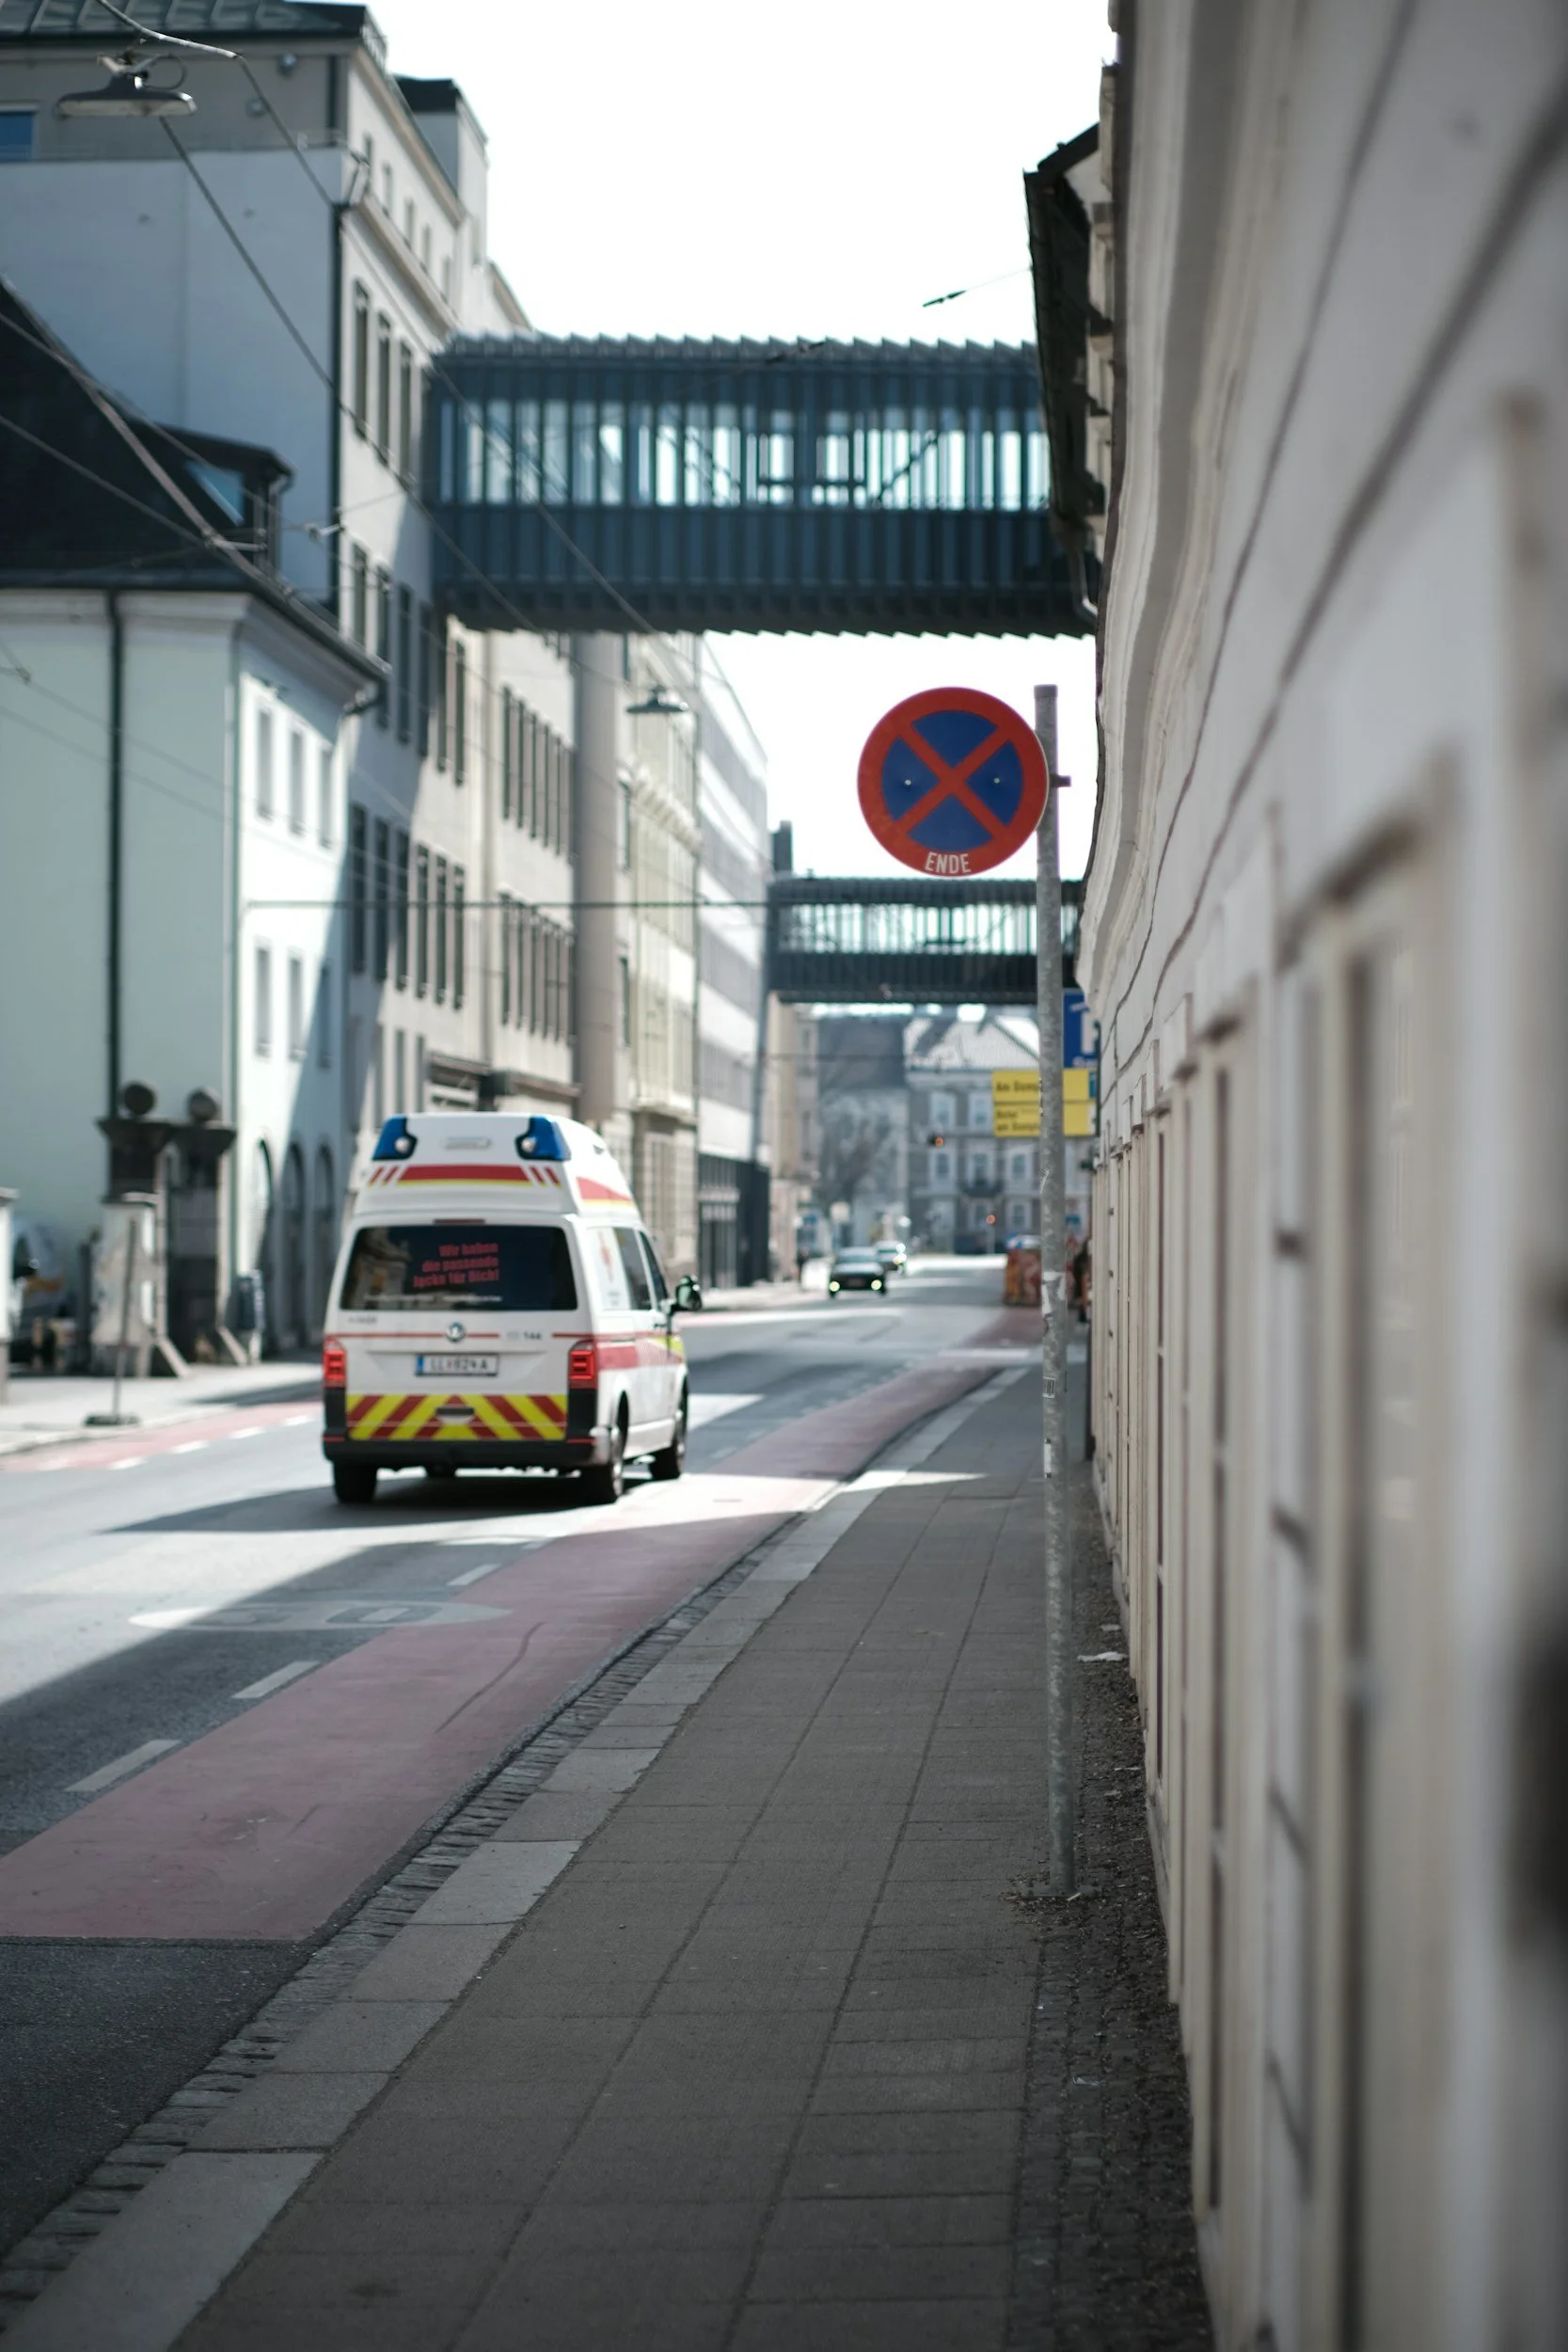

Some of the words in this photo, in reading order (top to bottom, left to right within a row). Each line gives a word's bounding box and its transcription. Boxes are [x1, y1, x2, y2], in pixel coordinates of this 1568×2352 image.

[925, 850, 972, 874] ENDE
[438, 1245, 459, 1257] Wir
[461, 1242, 499, 1256] haben
[421, 1259, 440, 1273] die
[442, 1255, 499, 1272] passende
